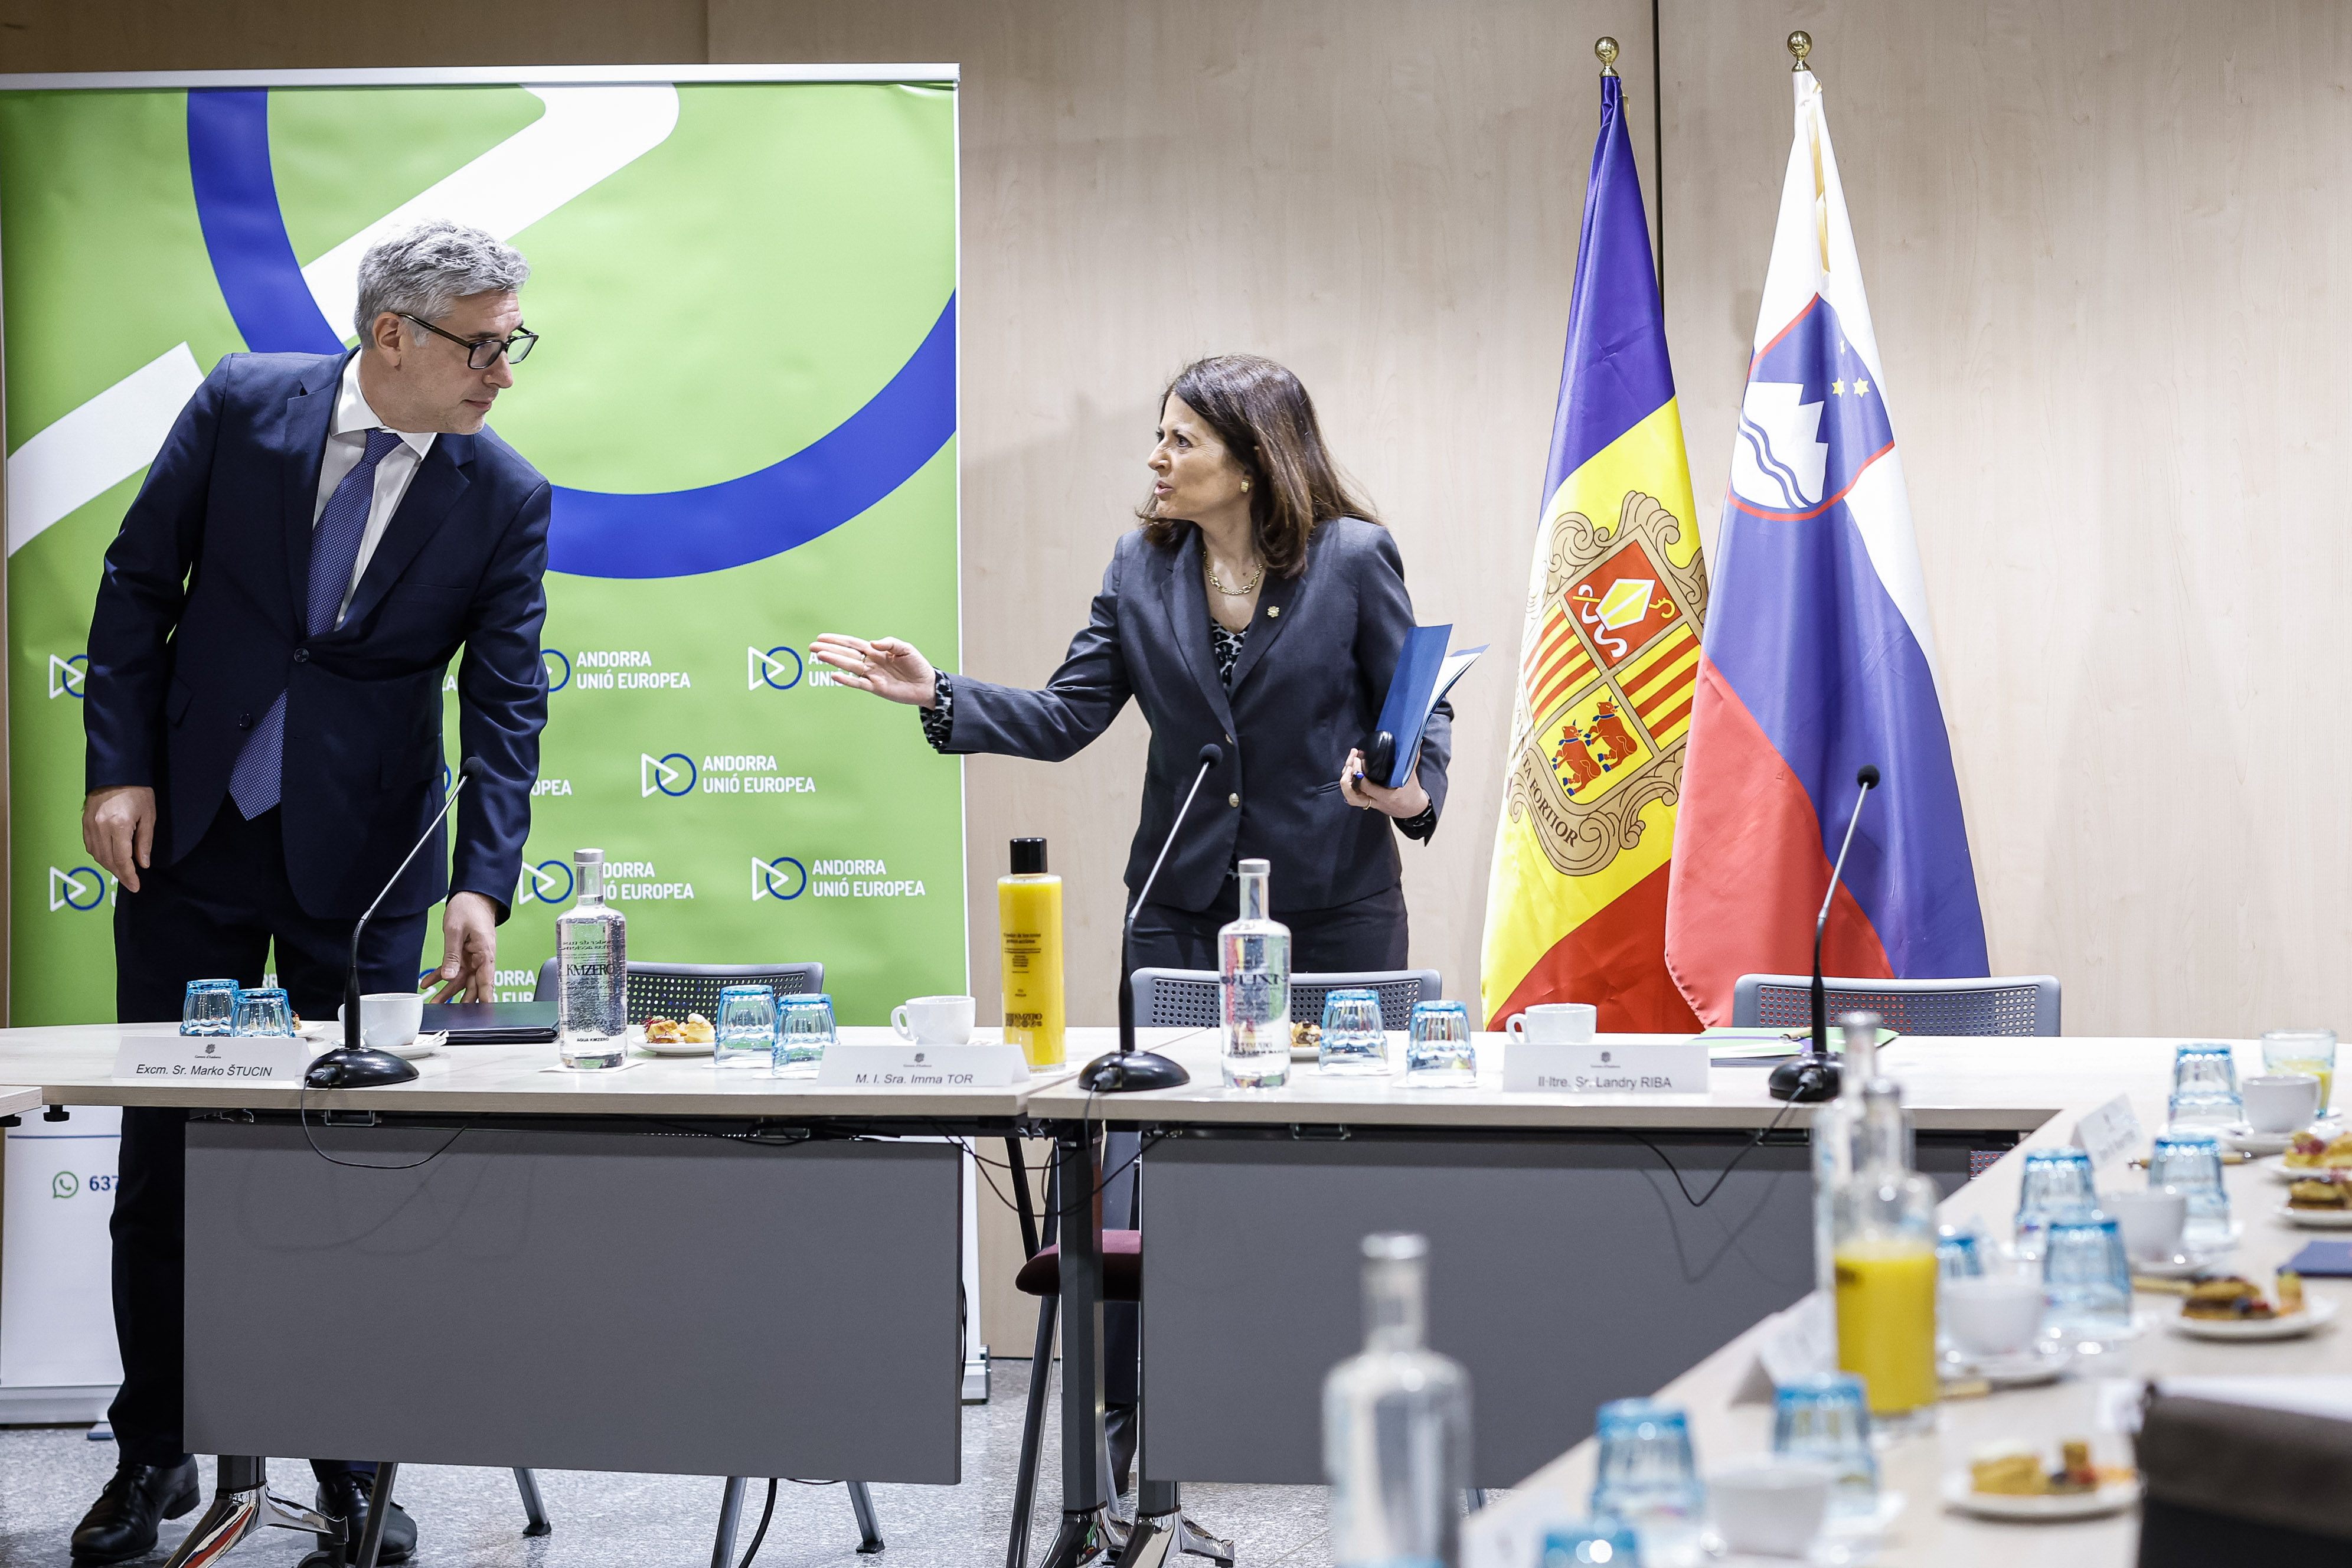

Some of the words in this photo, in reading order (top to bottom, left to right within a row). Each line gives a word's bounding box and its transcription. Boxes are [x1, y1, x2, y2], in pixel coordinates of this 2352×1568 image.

[576, 651, 652, 668] ANDORRA
[577, 669, 614, 690] UNIÓ
[618, 672, 691, 689] EUROPEA
[702, 755, 778, 772] ANDORRA
[531, 779, 573, 796] OPEA
[703, 773, 740, 793] UNIÓ
[744, 776, 816, 793] EUROPEA
[1529, 778, 1579, 848] FORTIOR
[602, 861, 656, 878] DORRA
[812, 859, 887, 876] ANDORRA
[621, 883, 695, 900] EUROPEA
[812, 877, 850, 897] UNIÓ
[853, 880, 926, 897] EUROPEA
[494, 969, 536, 986] ORRA
[567, 963, 615, 976] KMZERO
[136, 1064, 168, 1075] Excm.
[172, 1065, 187, 1076] Sr.
[191, 1066, 224, 1076] Marko
[227, 1064, 273, 1077] ŠTUCIN
[855, 1074, 869, 1084] M.
[873, 1074, 880, 1084] I.
[884, 1074, 907, 1084] Sra.
[911, 1074, 943, 1084] Imma
[947, 1074, 974, 1084] TOR
[1596, 1077, 1637, 1090] Landry
[1641, 1076, 1672, 1089] RIBA
